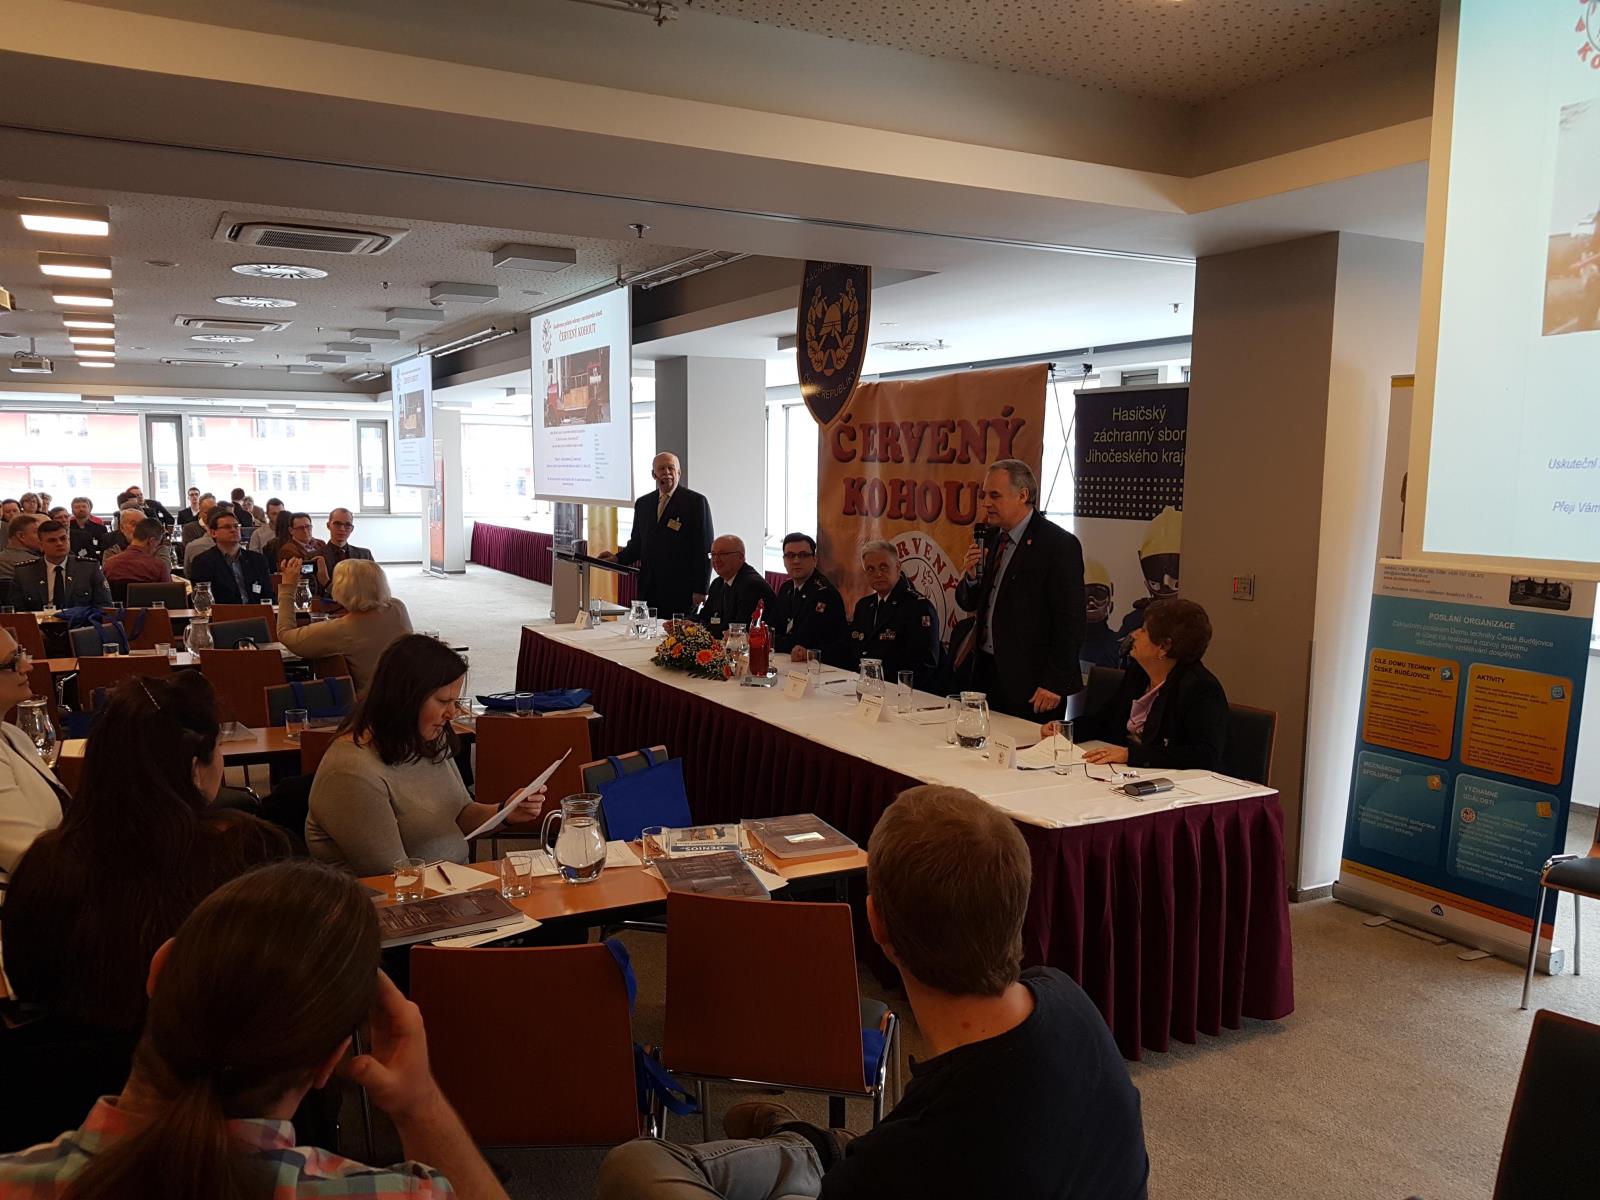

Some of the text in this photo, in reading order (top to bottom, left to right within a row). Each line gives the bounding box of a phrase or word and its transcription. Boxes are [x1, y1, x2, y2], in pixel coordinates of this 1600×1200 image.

[1112, 404, 1167, 423] Hasičský
[831, 405, 1026, 465] ČERVENÝ
[1093, 426, 1186, 445] záchranný sbor
[1085, 448, 1185, 467] Jihočeského kraj
[1548, 457, 1599, 470] Uskuteční
[842, 476, 984, 526] KOHOU
[1552, 500, 1576, 515] Přeji
[1463, 616, 1517, 631] ORGANIZACE
[1518, 636, 1554, 648] Budějovice
[1388, 660, 1406, 668] DOMU
[1407, 662, 1436, 672] TECHNIKY
[1476, 674, 1506, 685] AKTIVITY
